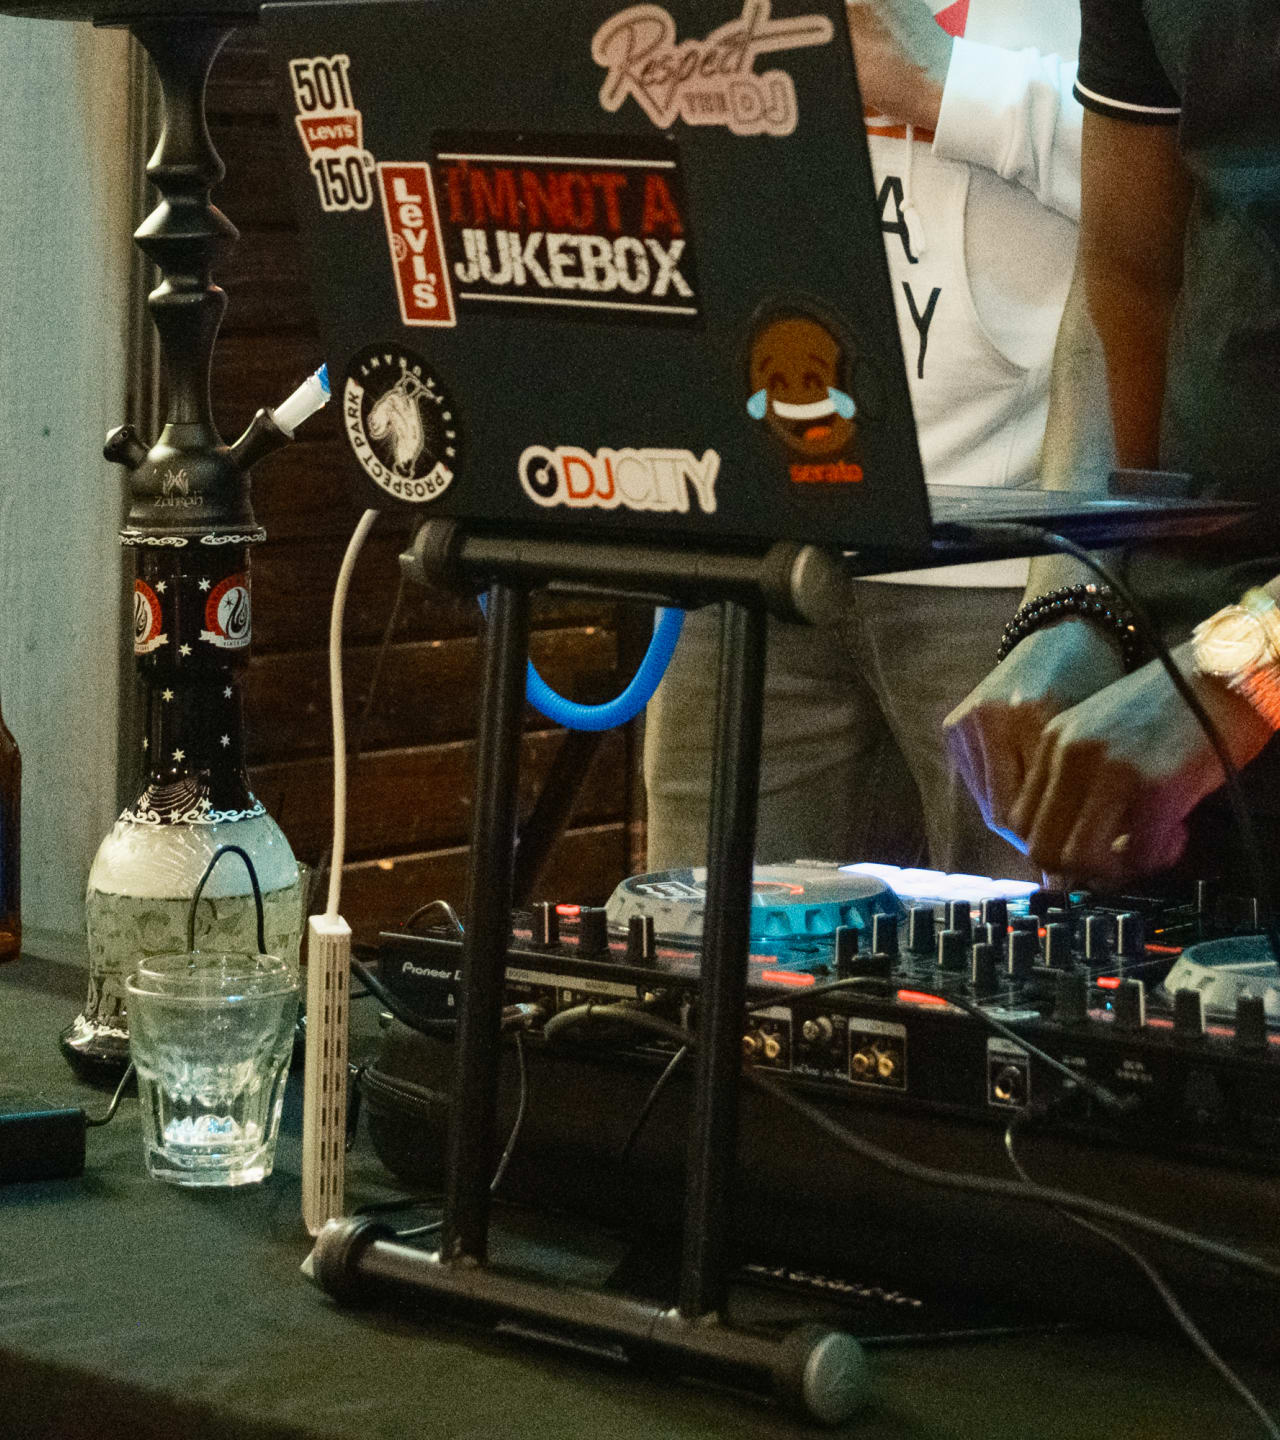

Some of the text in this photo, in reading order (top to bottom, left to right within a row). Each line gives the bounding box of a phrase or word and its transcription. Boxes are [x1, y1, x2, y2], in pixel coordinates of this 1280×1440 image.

[293, 59, 350, 112] 501
[600, 4, 826, 117] Respect
[728, 79, 791, 126] DJ
[314, 156, 367, 207] 150
[521, 170, 627, 234] NOT
[641, 174, 683, 234] A
[454, 228, 695, 297] JUKEBOX
[347, 391, 446, 497] PROSPECT PARK
[402, 961, 451, 980] Pioneer
